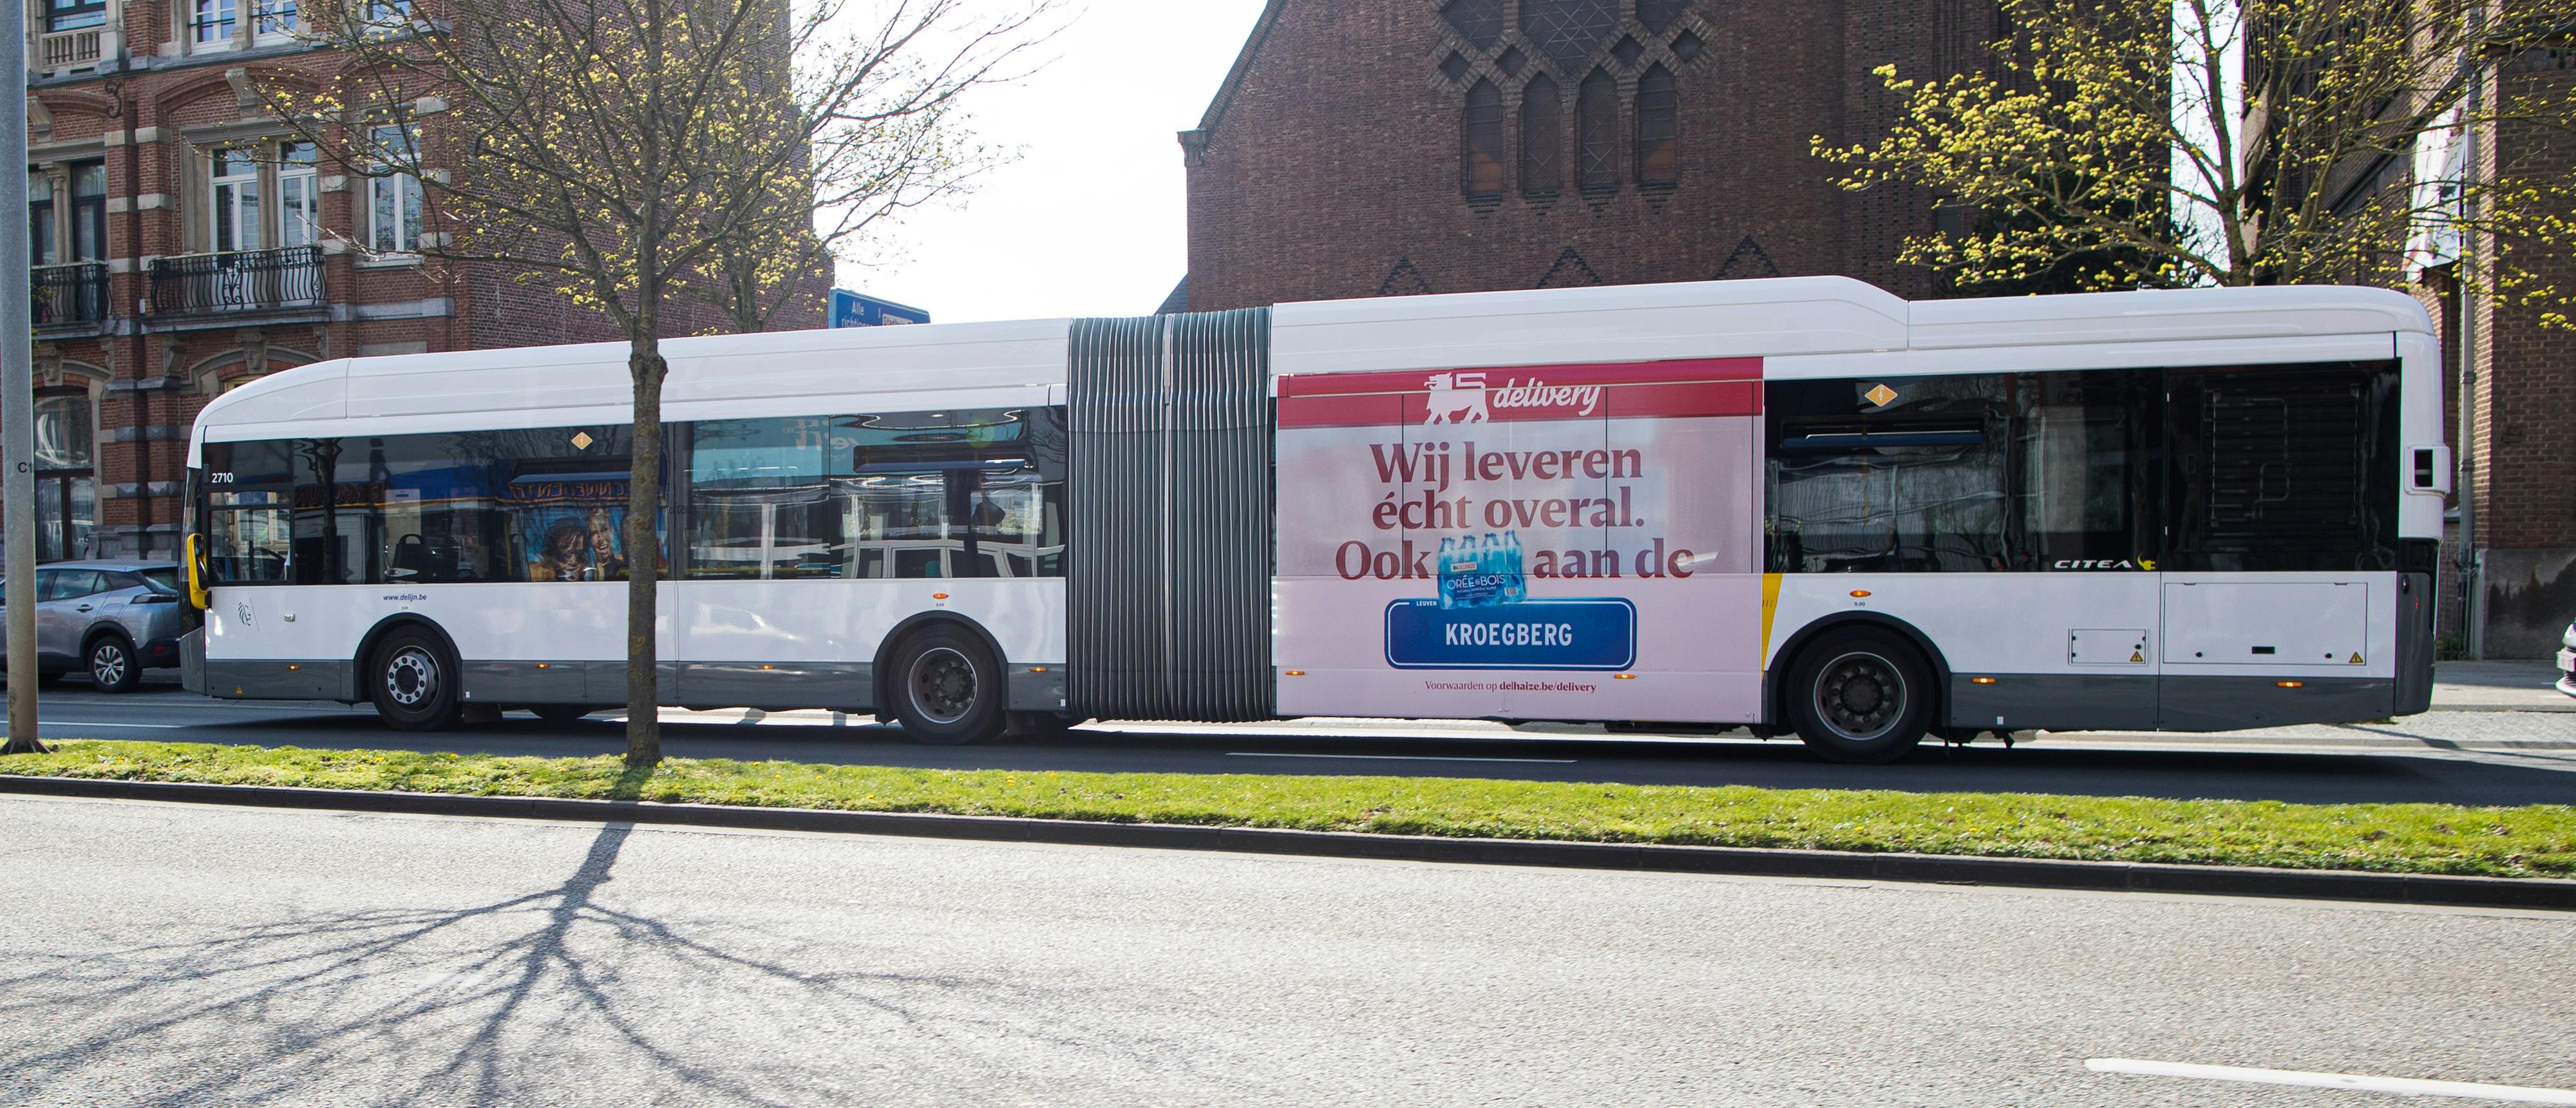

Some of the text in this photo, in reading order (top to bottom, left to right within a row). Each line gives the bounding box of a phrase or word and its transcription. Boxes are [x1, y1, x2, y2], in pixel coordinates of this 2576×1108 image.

[851, 301, 864, 316] Alle
[1493, 377, 1601, 416] delivery
[1370, 441, 1643, 493] Wij leveren
[212, 472, 234, 483] 2710
[1372, 486, 1645, 530] écht overal.
[1336, 538, 1695, 580] Ook aan de
[2054, 560, 2132, 568] CITEA
[1446, 575, 1475, 590] ORÉE
[1481, 574, 1506, 586] BOIS
[1446, 623, 1573, 646] KROEGBERG
[1425, 681, 1596, 694] Voorwaarden op delhaize.be/delivery
